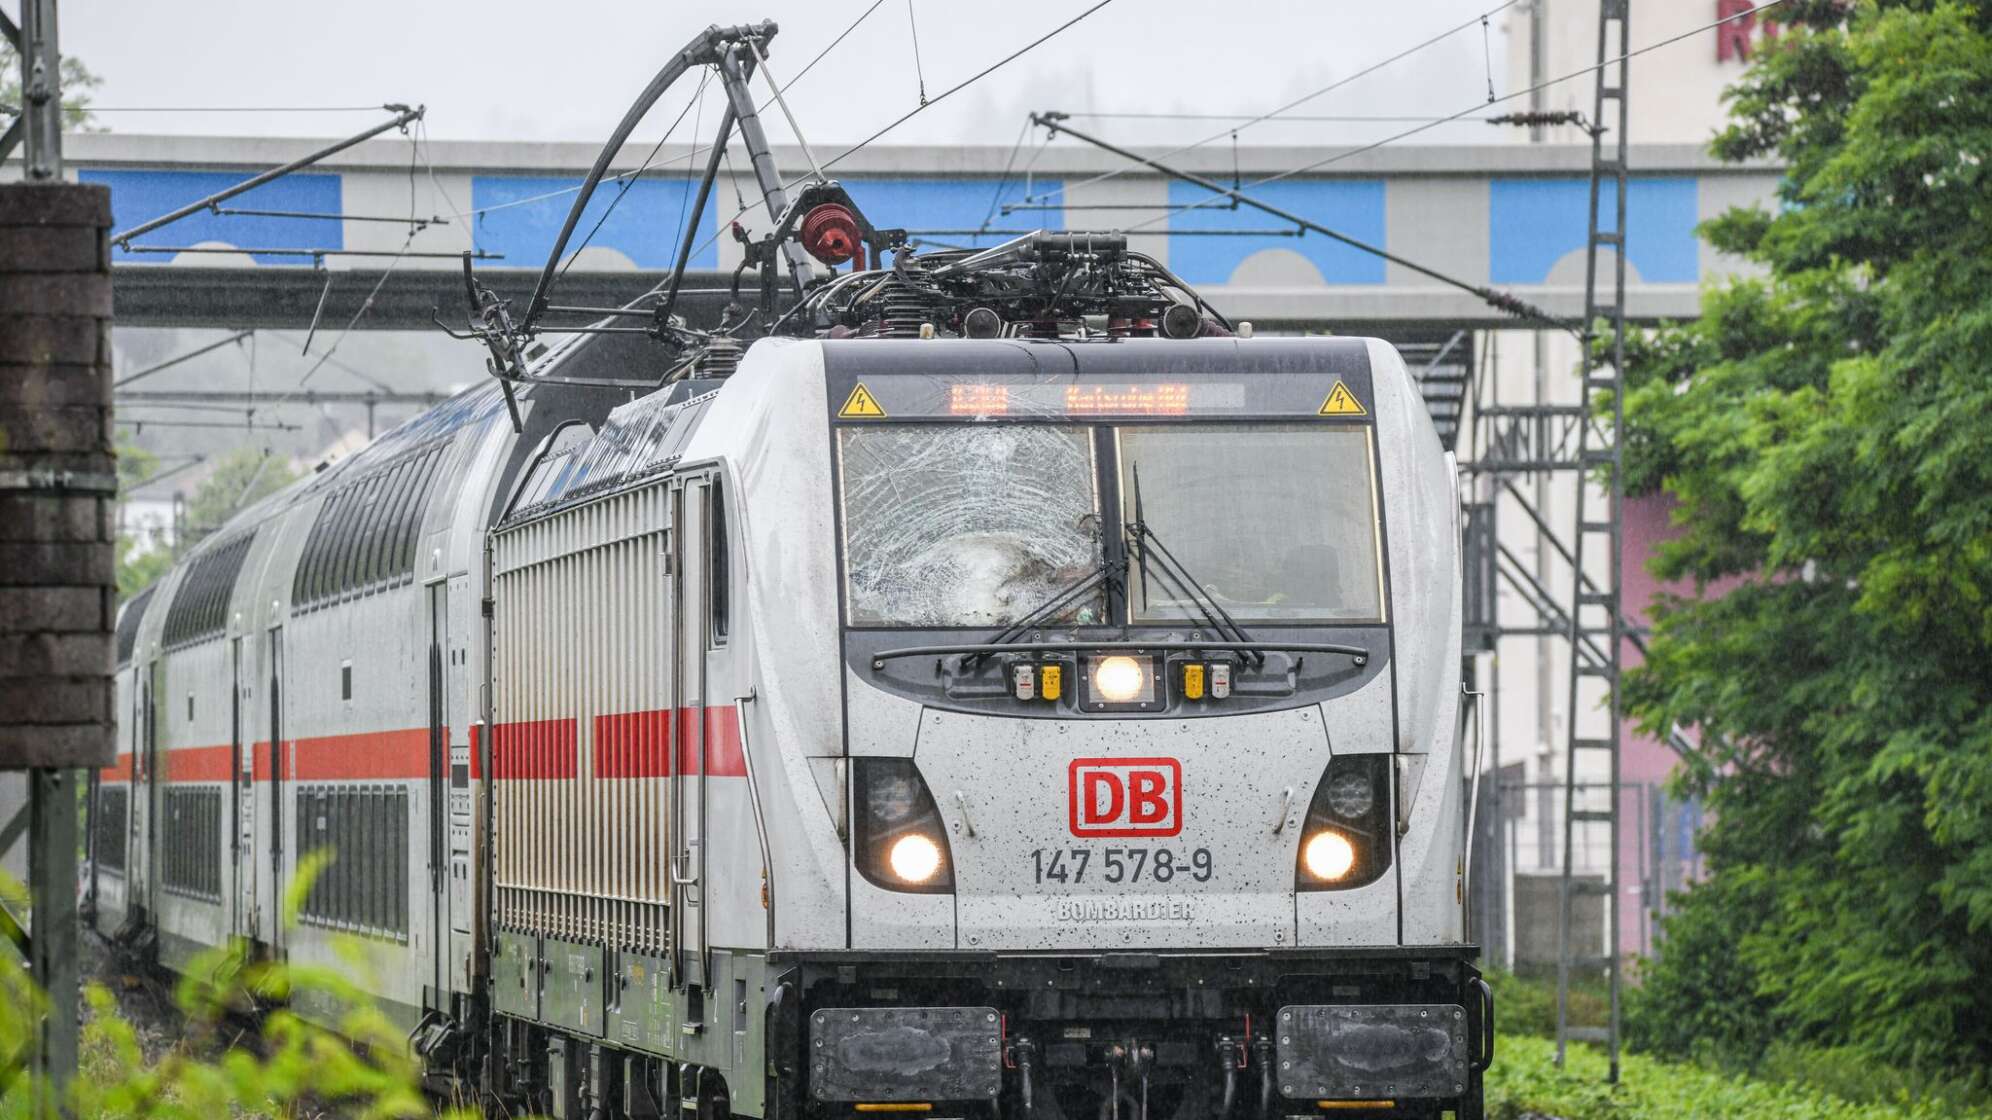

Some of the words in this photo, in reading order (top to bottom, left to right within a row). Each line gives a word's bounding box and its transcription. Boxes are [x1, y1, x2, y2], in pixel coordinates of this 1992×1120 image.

[1082, 769, 1170, 826] DB
[1030, 848, 1091, 885] 147
[1103, 847, 1213, 884] 578-9
[1057, 899, 1197, 922] BOMBARDIER
